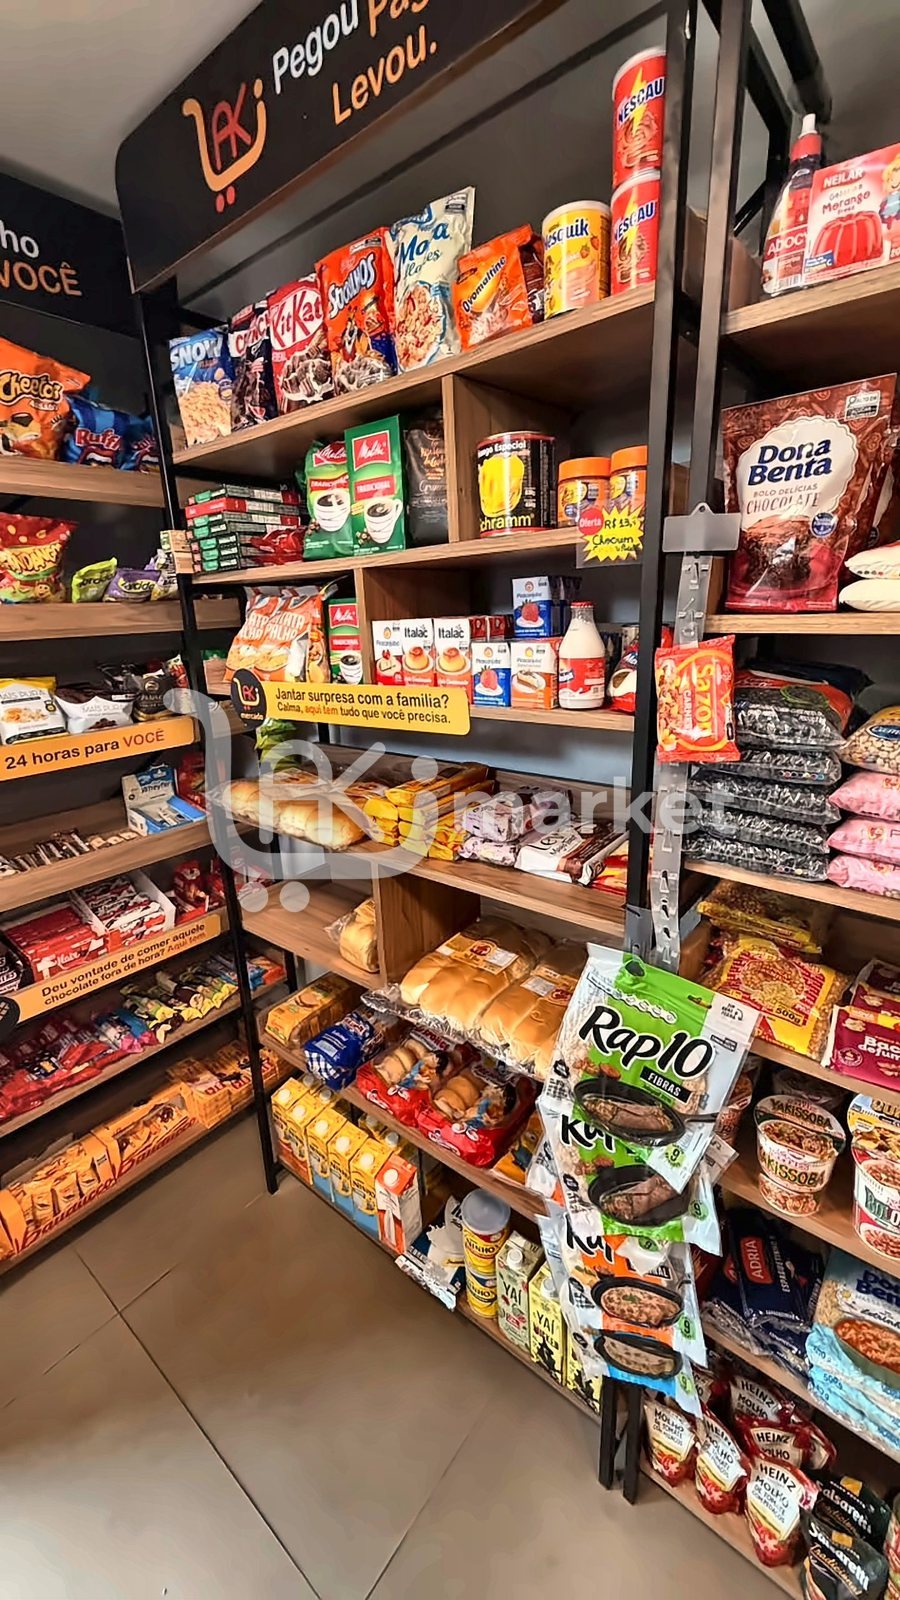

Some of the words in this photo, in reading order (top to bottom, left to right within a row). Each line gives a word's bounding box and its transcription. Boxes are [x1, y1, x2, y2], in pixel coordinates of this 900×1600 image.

[272, 0, 359, 94] Pegou
[332, 25, 438, 125] Levou.
[822, 190, 871, 214] Morango
[462, 256, 507, 313] Ovomaltine
[270, 290, 323, 348] KitKat
[169, 335, 224, 370] SNOW
[0, 370, 64, 401] Cheetos
[757, 438, 832, 466] Dona
[747, 457, 833, 487] Benta
[753, 489, 776, 498] BOLO
[579, 517, 603, 529] Oferta
[404, 626, 429, 640] Italac
[438, 626, 465, 640] Italac
[275, 687, 306, 701] Jantar
[308, 691, 355, 706] surpresa
[357, 694, 383, 706] com
[386, 696, 394, 706] a
[277, 702, 304, 714] Calma,
[305, 704, 322, 715] aqui
[323, 706, 339, 716] tem
[340, 706, 361, 717] tudo
[362, 709, 380, 720] que
[381, 708, 406, 721] você
[407, 711, 451, 725] precisa.
[5, 755, 29, 770] 24
[32, 746, 81, 766] horas
[84, 740, 120, 760] para
[122, 728, 165, 749] VOCÊ
[41, 981, 68, 998] Deu
[69, 959, 118, 983] vontade
[120, 951, 135, 963] de
[136, 938, 171, 957] comer
[171, 922, 206, 944] aquele
[44, 979, 99, 1006] chocolate
[100, 967, 122, 984] fora
[123, 958, 137, 972] de
[138, 949, 166, 966] hora?
[578, 1005, 714, 1078] Rap10
[646, 1071, 682, 1098] FIBRAS
[670, 1147, 681, 1161] 9
[745, 1240, 764, 1279] ADRIA
[740, 1379, 776, 1408] HEINZ
[654, 1408, 685, 1433] MOLHO
[756, 1431, 791, 1445] HEINZ
[760, 1463, 797, 1493] HEINZ
